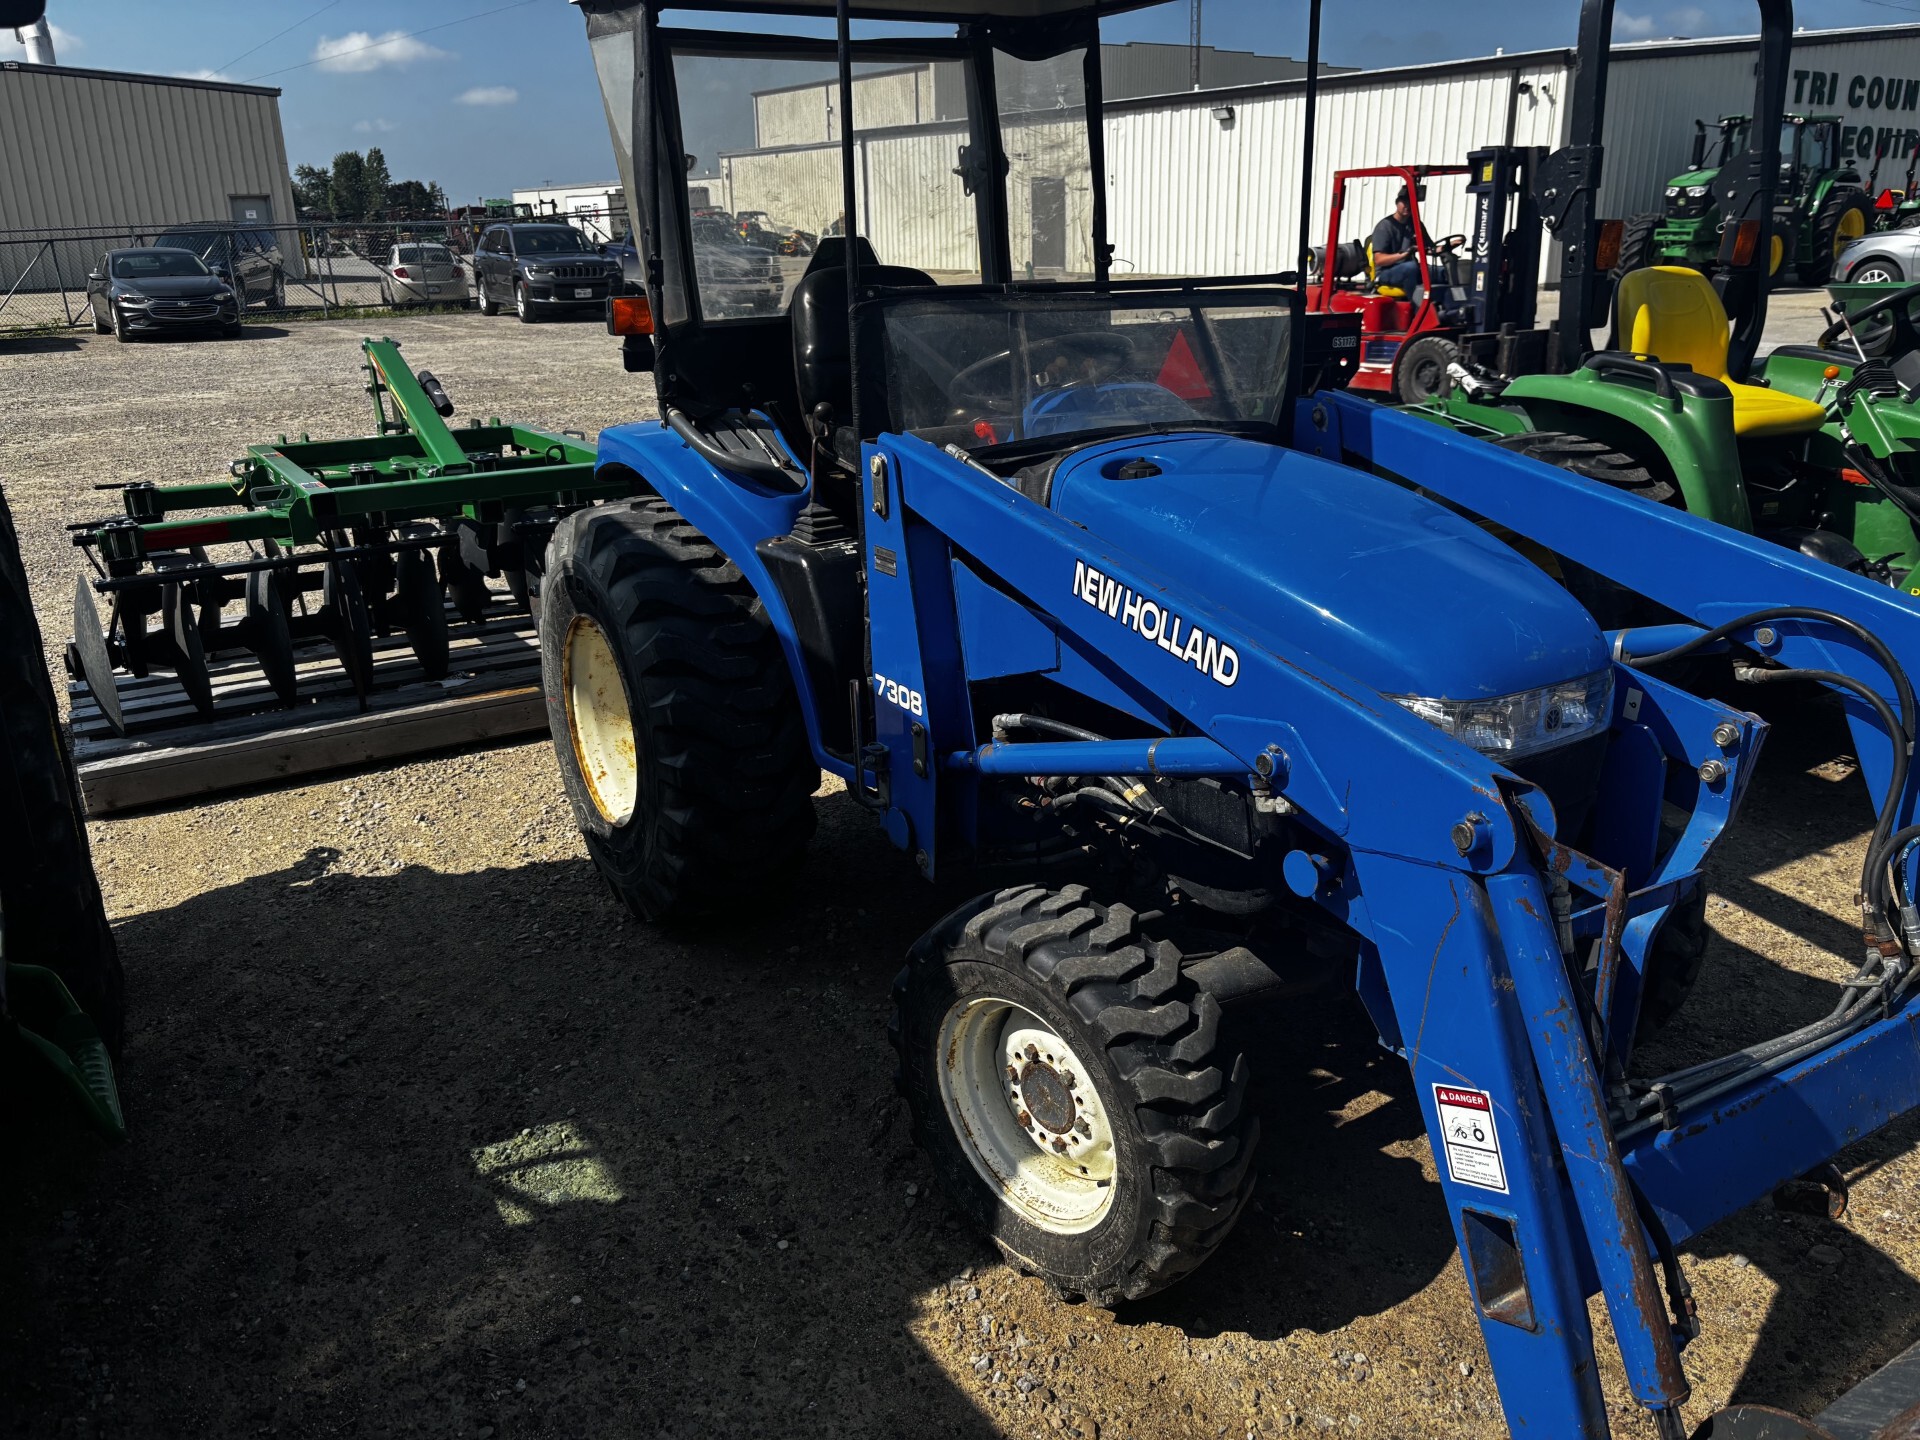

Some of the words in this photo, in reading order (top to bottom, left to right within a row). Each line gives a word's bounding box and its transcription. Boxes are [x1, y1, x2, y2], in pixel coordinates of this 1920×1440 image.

[1794, 70, 1839, 105] TRI
[1848, 75, 1920, 111] COUN
[1840, 126, 1920, 159] EQUIP
[1482, 198, 1489, 210] AC
[1478, 211, 1488, 243] Kalmar
[1073, 559, 1123, 620] NEW
[1121, 588, 1240, 687] HOLLAND
[875, 673, 923, 716] 7308
[1449, 1093, 1484, 1105] DANGER
